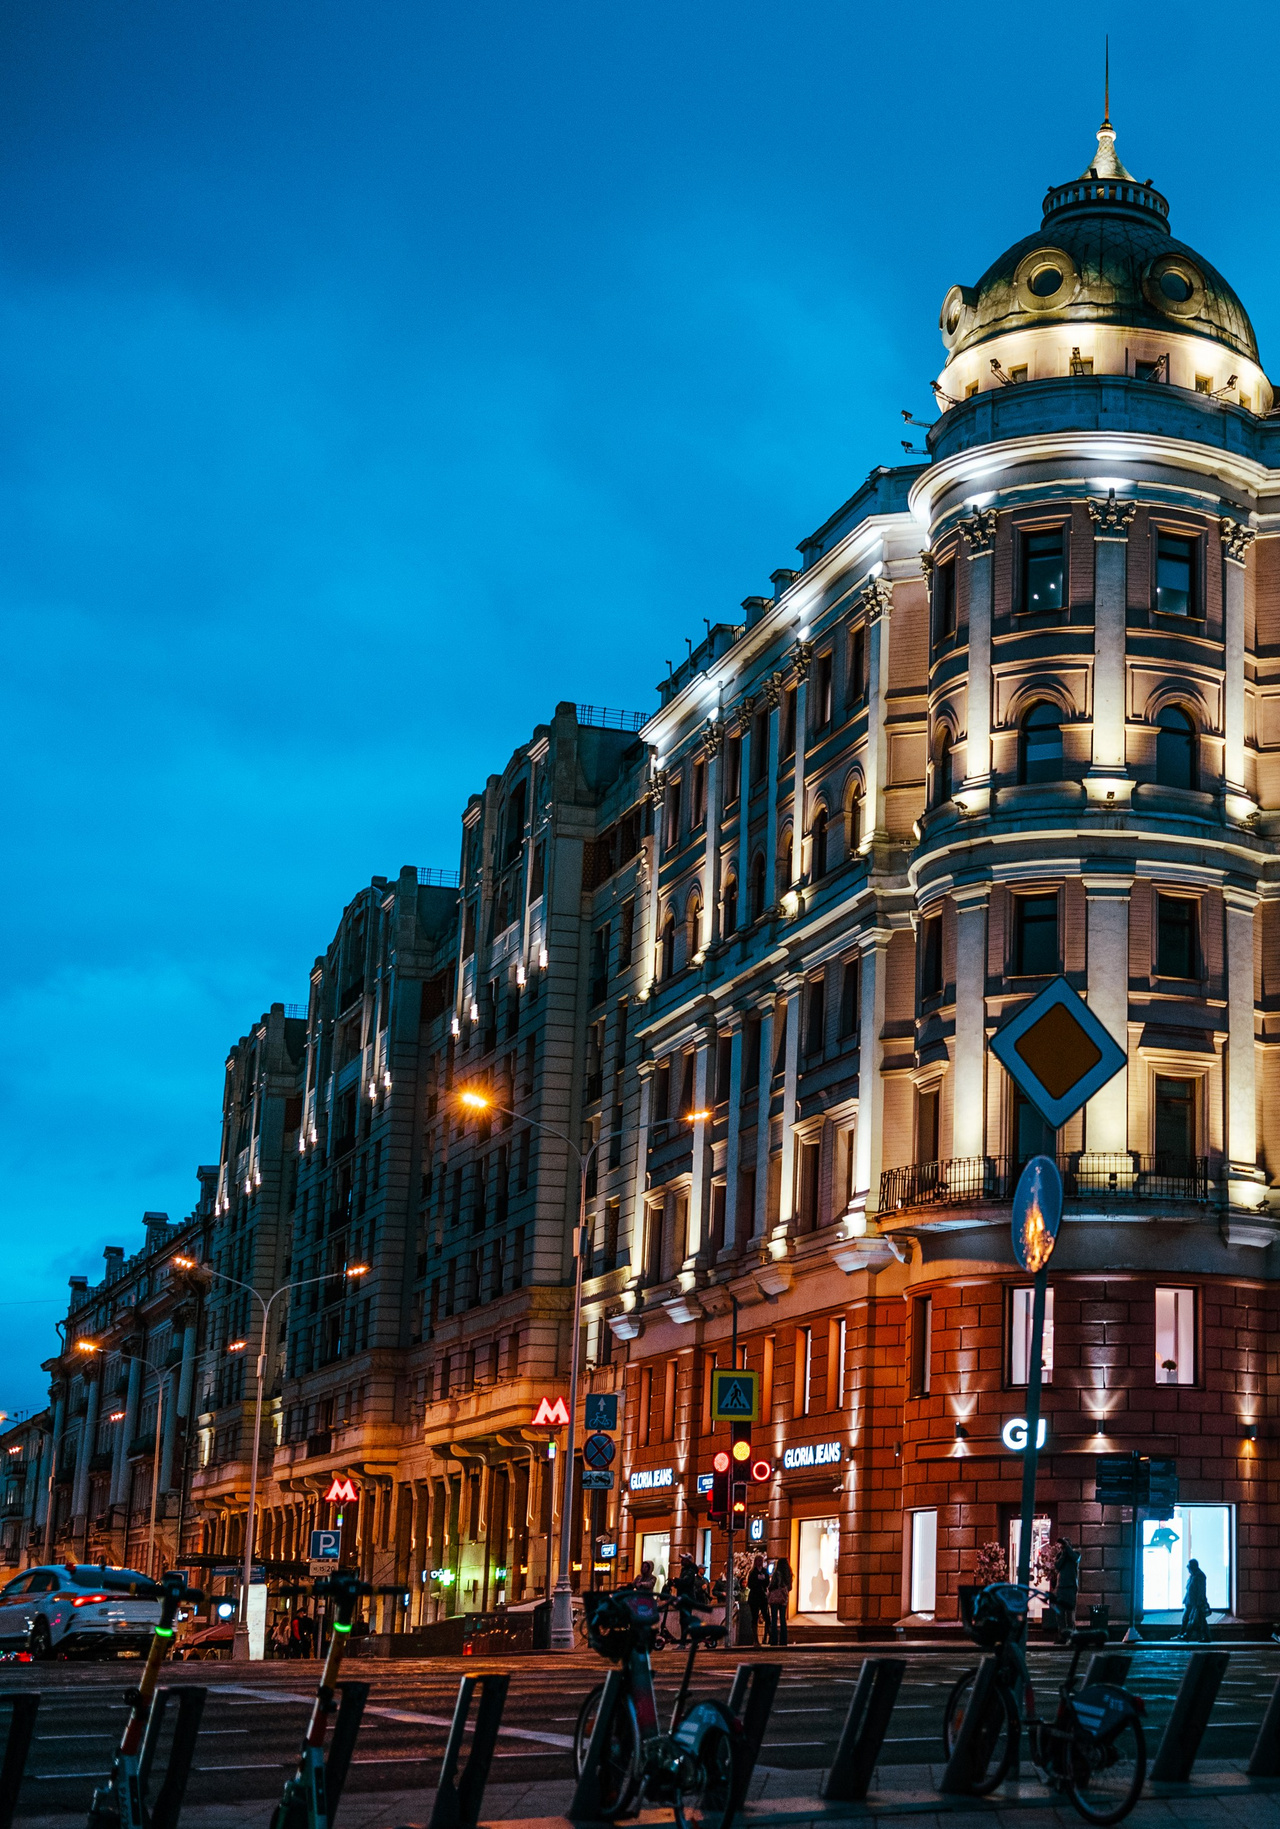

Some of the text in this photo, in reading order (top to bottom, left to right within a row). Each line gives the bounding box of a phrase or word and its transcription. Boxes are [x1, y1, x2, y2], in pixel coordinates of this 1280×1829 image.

[1002, 1418, 1046, 1450] GJ
[784, 1441, 841, 1469] GLORIA JEANS
[630, 1467, 673, 1490] GLORIA JEANS
[319, 1534, 335, 1556] P
